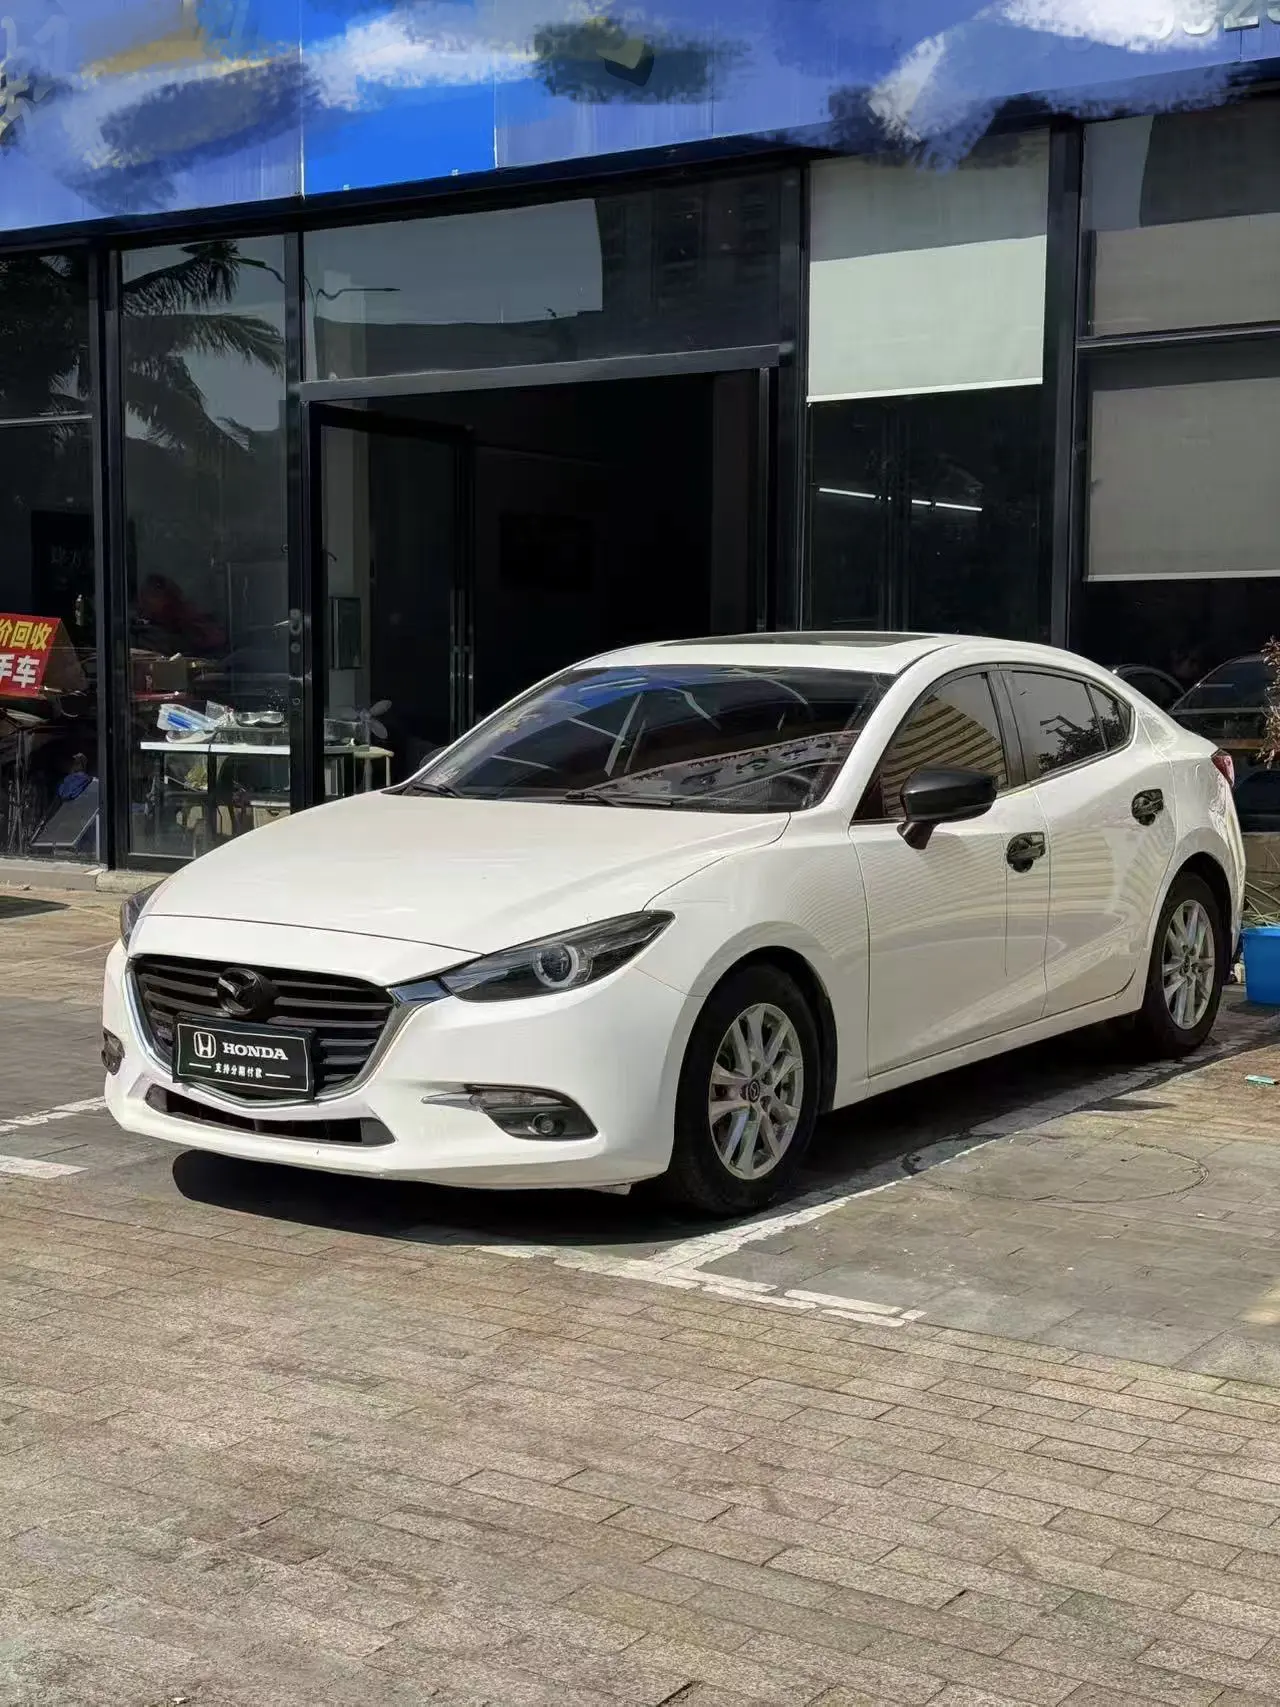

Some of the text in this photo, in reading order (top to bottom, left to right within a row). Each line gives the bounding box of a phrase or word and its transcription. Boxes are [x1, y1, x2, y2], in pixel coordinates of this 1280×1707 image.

[222, 1042, 289, 1060] HONDA
[214, 1062, 263, 1079] 支持分期付款
